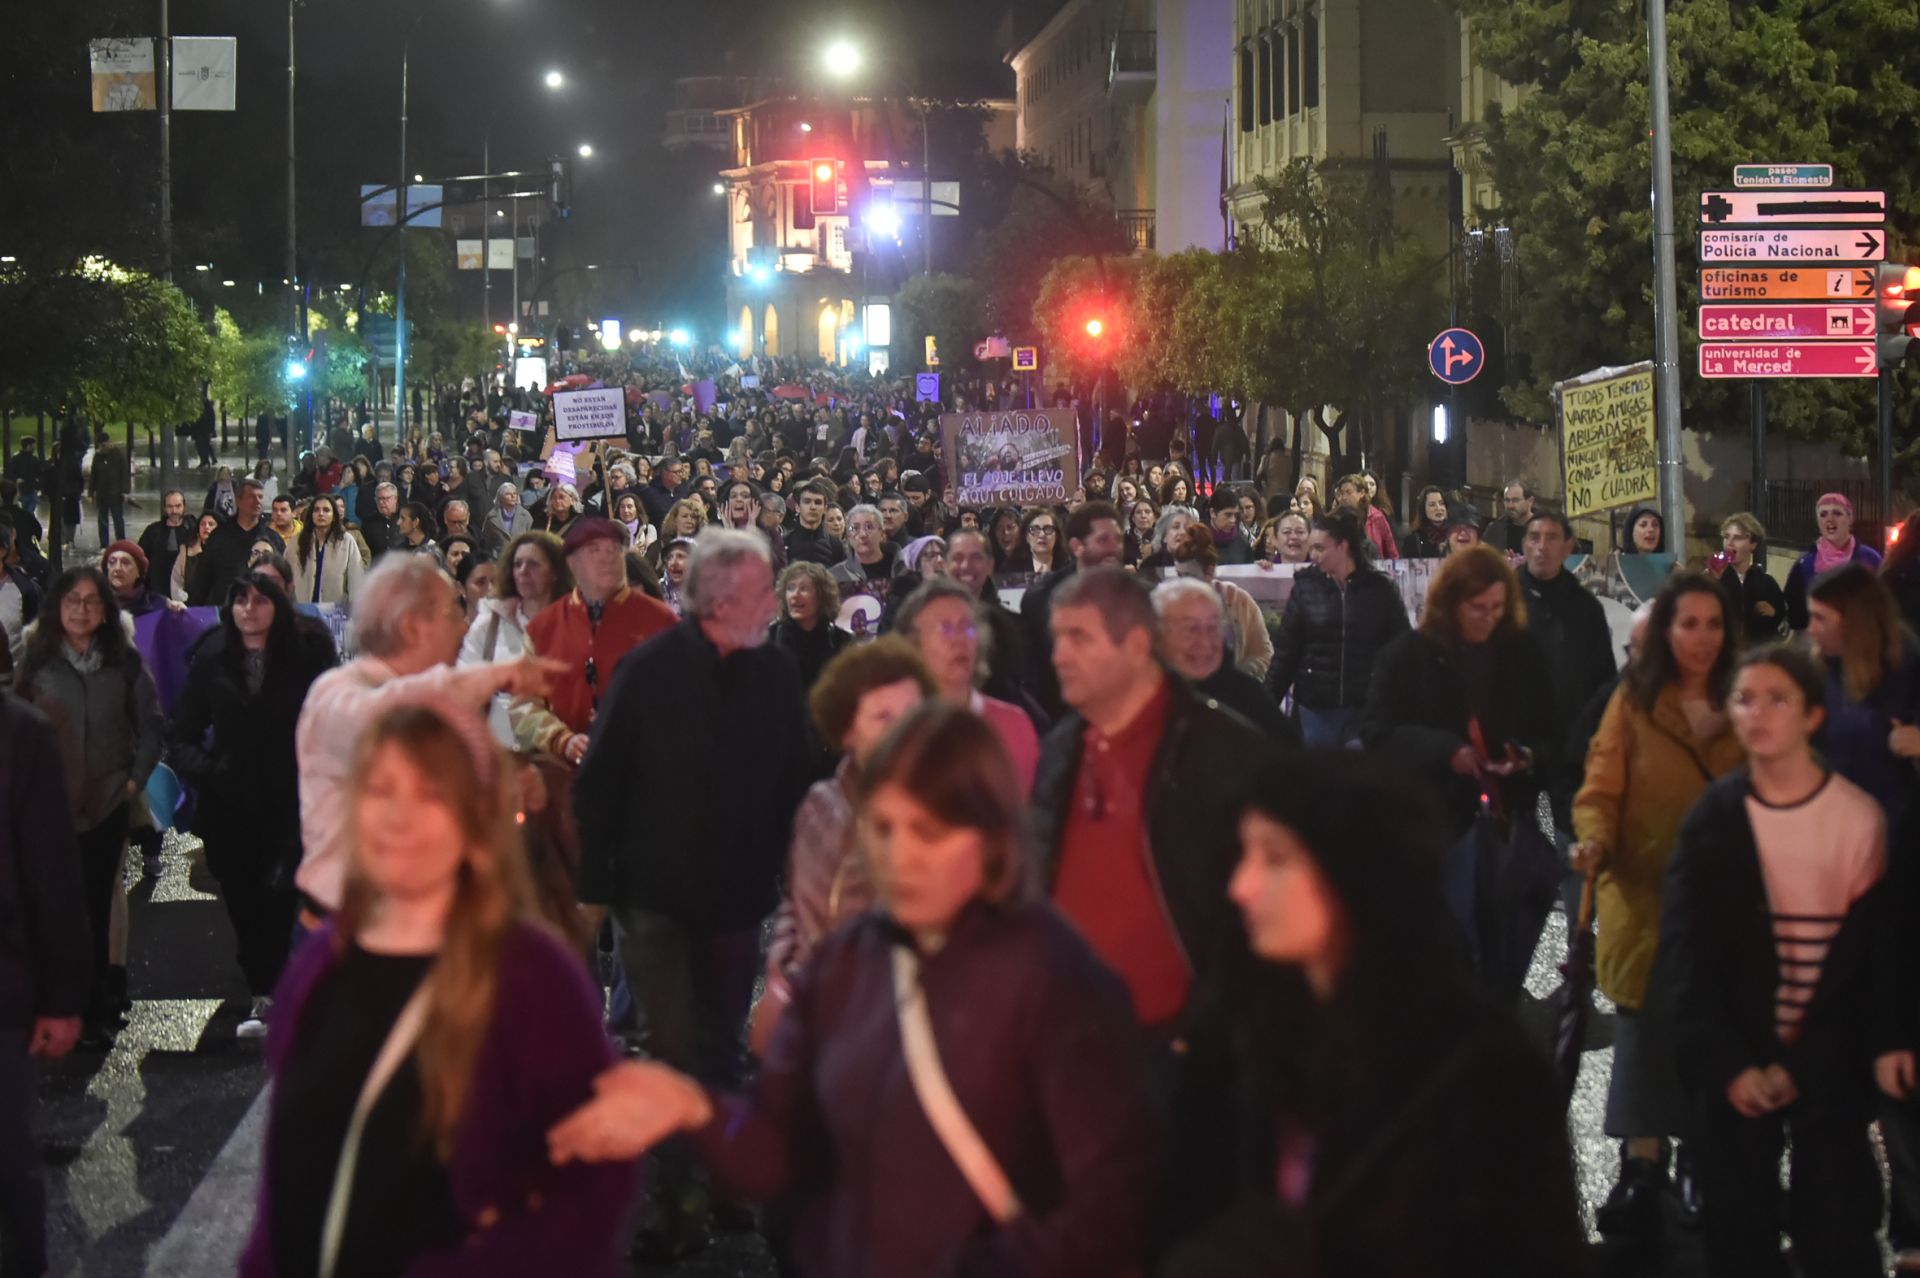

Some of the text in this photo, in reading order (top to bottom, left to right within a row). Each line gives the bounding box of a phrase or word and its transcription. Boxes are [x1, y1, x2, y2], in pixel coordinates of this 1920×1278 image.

[1768, 167, 1798, 176] paseo
[1737, 175, 1781, 184] Teniente
[1704, 232, 1788, 243] comisaría de
[1704, 244, 1840, 257] Policía Nacional
[1704, 271, 1799, 283] oficinas de
[1704, 284, 1767, 297] turismo
[1705, 314, 1795, 331] catedral
[1705, 349, 1801, 359] universidad de
[1705, 360, 1792, 373] La Merced
[1566, 388, 1604, 406] TODAS
[1566, 397, 1648, 426] VARIAS AMIGAS
[964, 469, 1064, 486] EL QUE LLEVO
